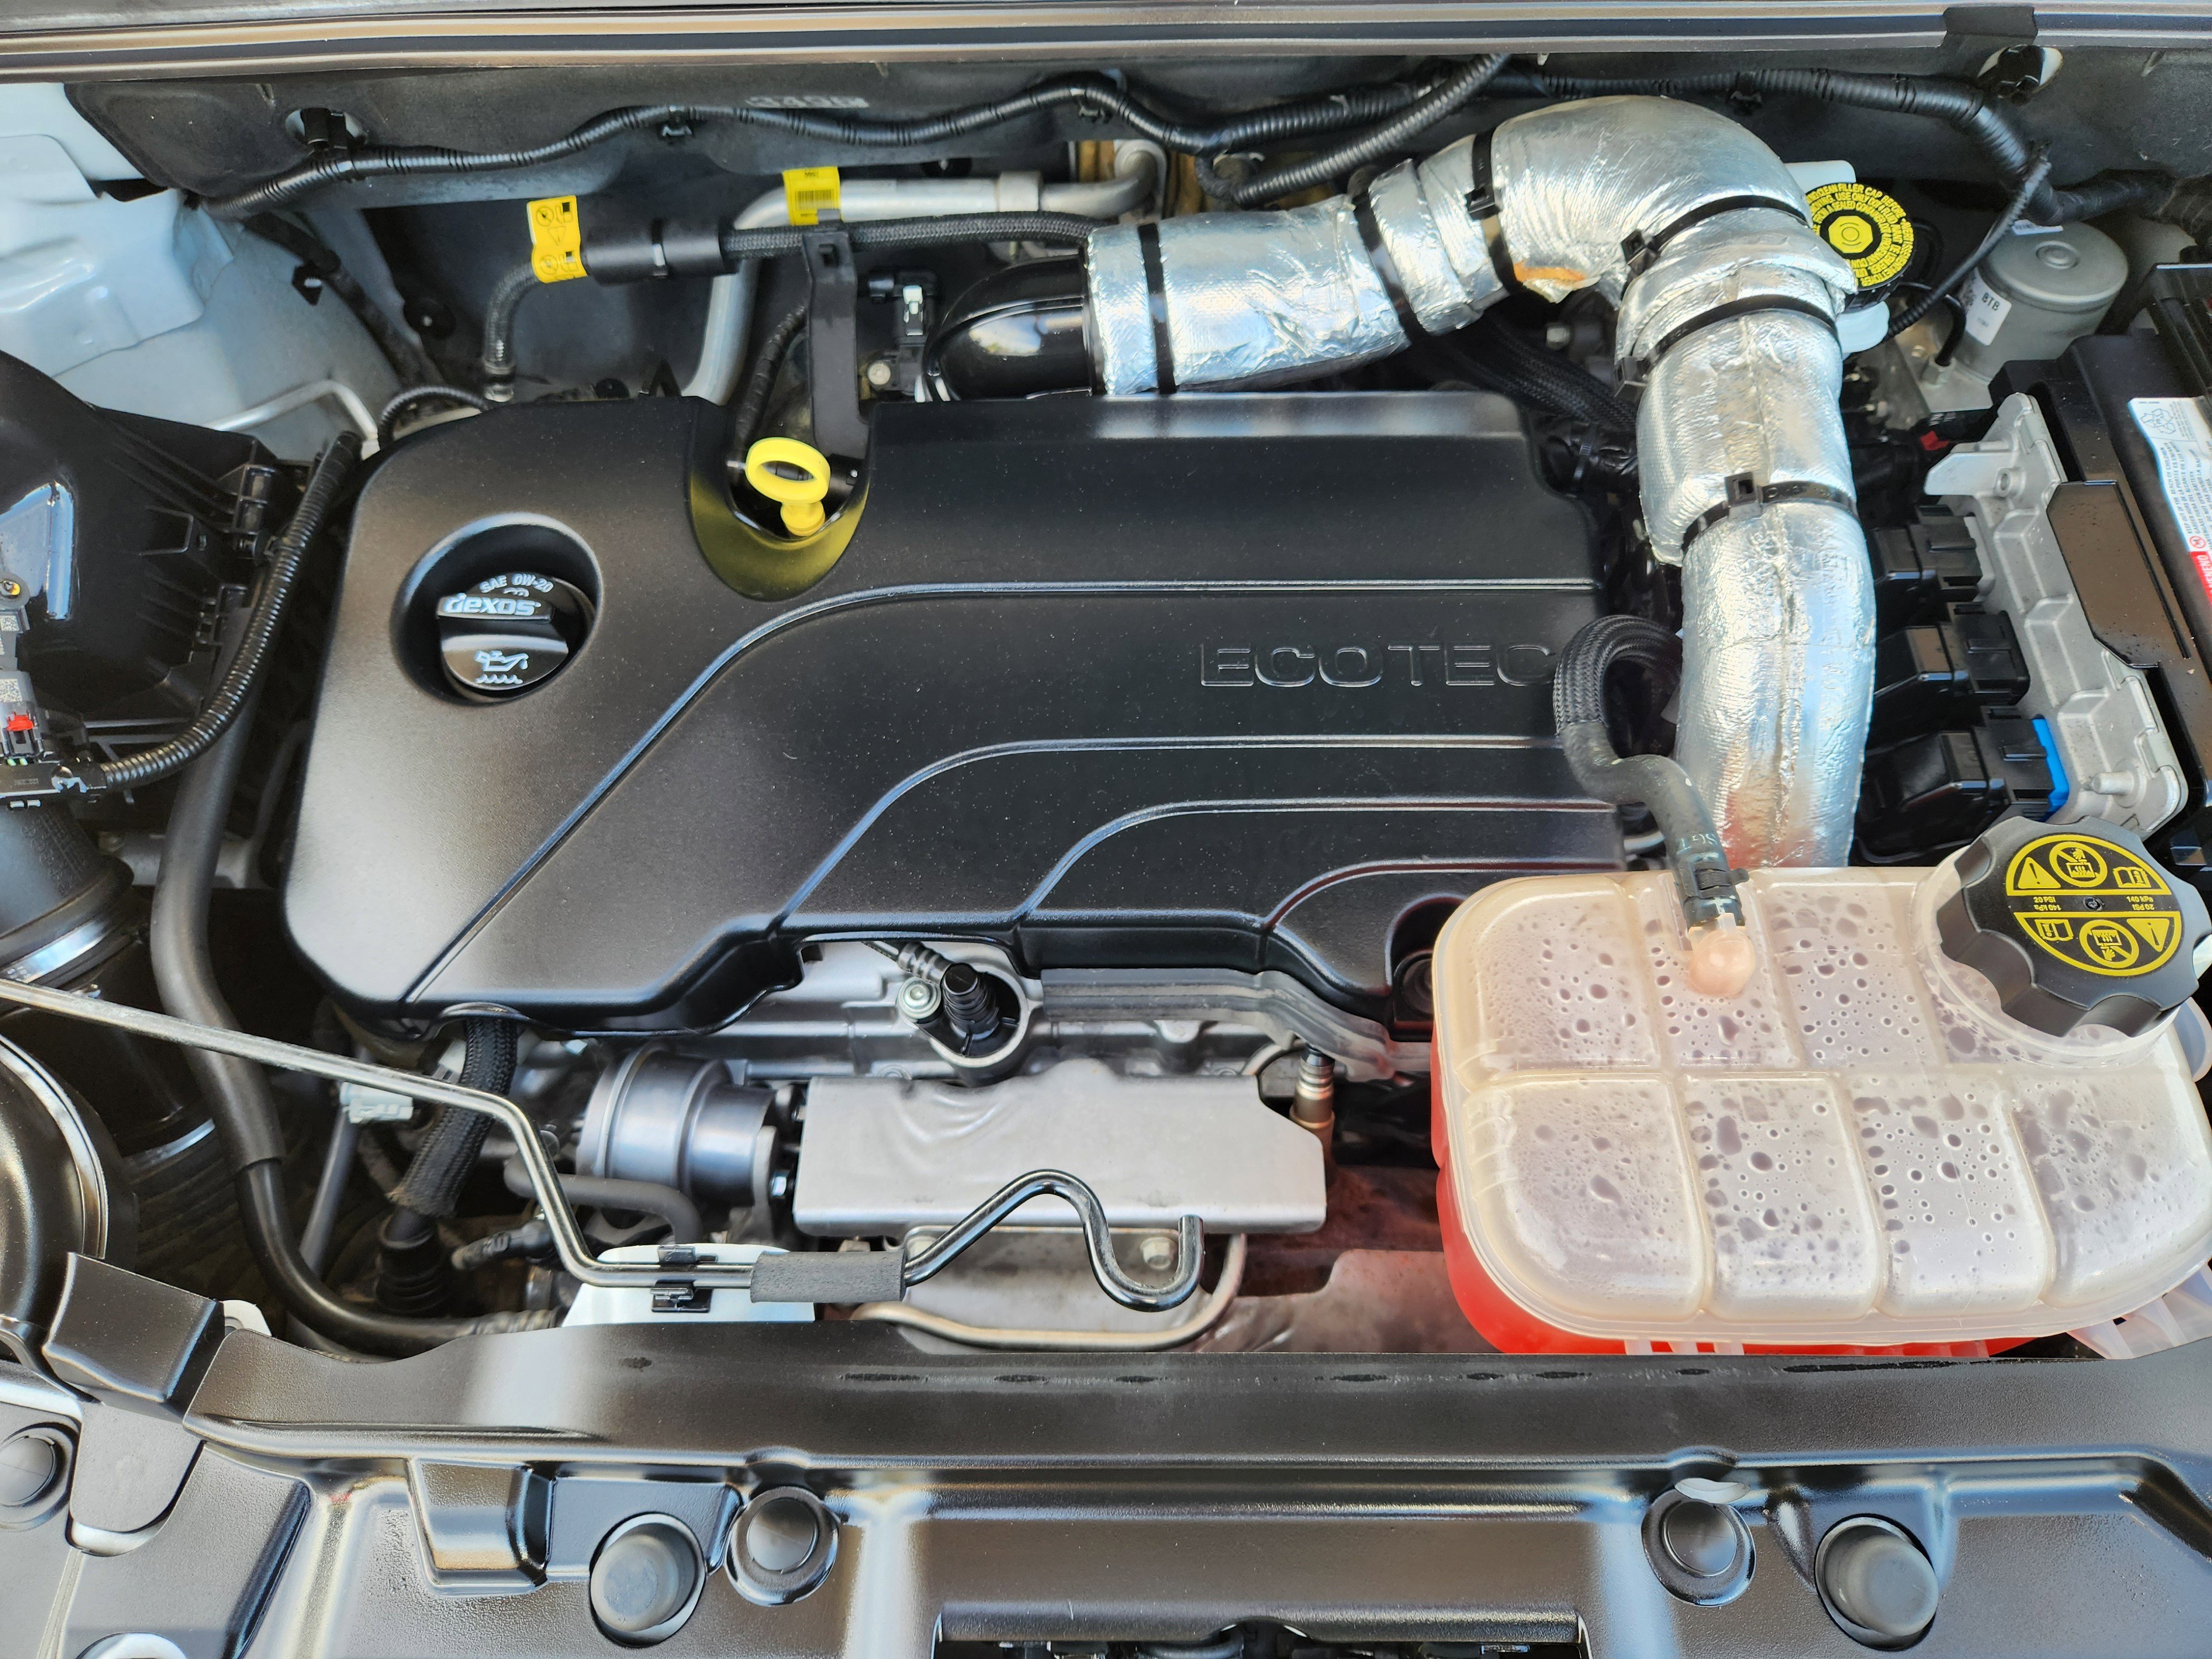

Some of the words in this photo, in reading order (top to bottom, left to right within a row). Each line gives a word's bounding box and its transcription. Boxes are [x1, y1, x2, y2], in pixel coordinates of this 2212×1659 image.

[1831, 201, 1856, 211] SEALED
[1835, 191, 1851, 201] USE
[1851, 192, 1870, 203] ONLY
[1881, 207, 1898, 224] FLUID
[1837, 183, 1864, 194] FILLER
[1865, 187, 1883, 199] CAP
[1881, 195, 1906, 219] BEFORE
[1890, 244, 1902, 254] DE
[2167, 479, 2176, 494] REACH
[2195, 492, 2204, 504] OPEN
[2183, 503, 2192, 514] HORS
[2192, 503, 2200, 517] FUERA
[2184, 523, 2192, 533] KEEP
[2189, 515, 2200, 533] GARDER
[479, 575, 507, 593] SAE
[512, 573, 554, 593] 0W-20
[1201, 643, 1553, 686] ECOTEC
